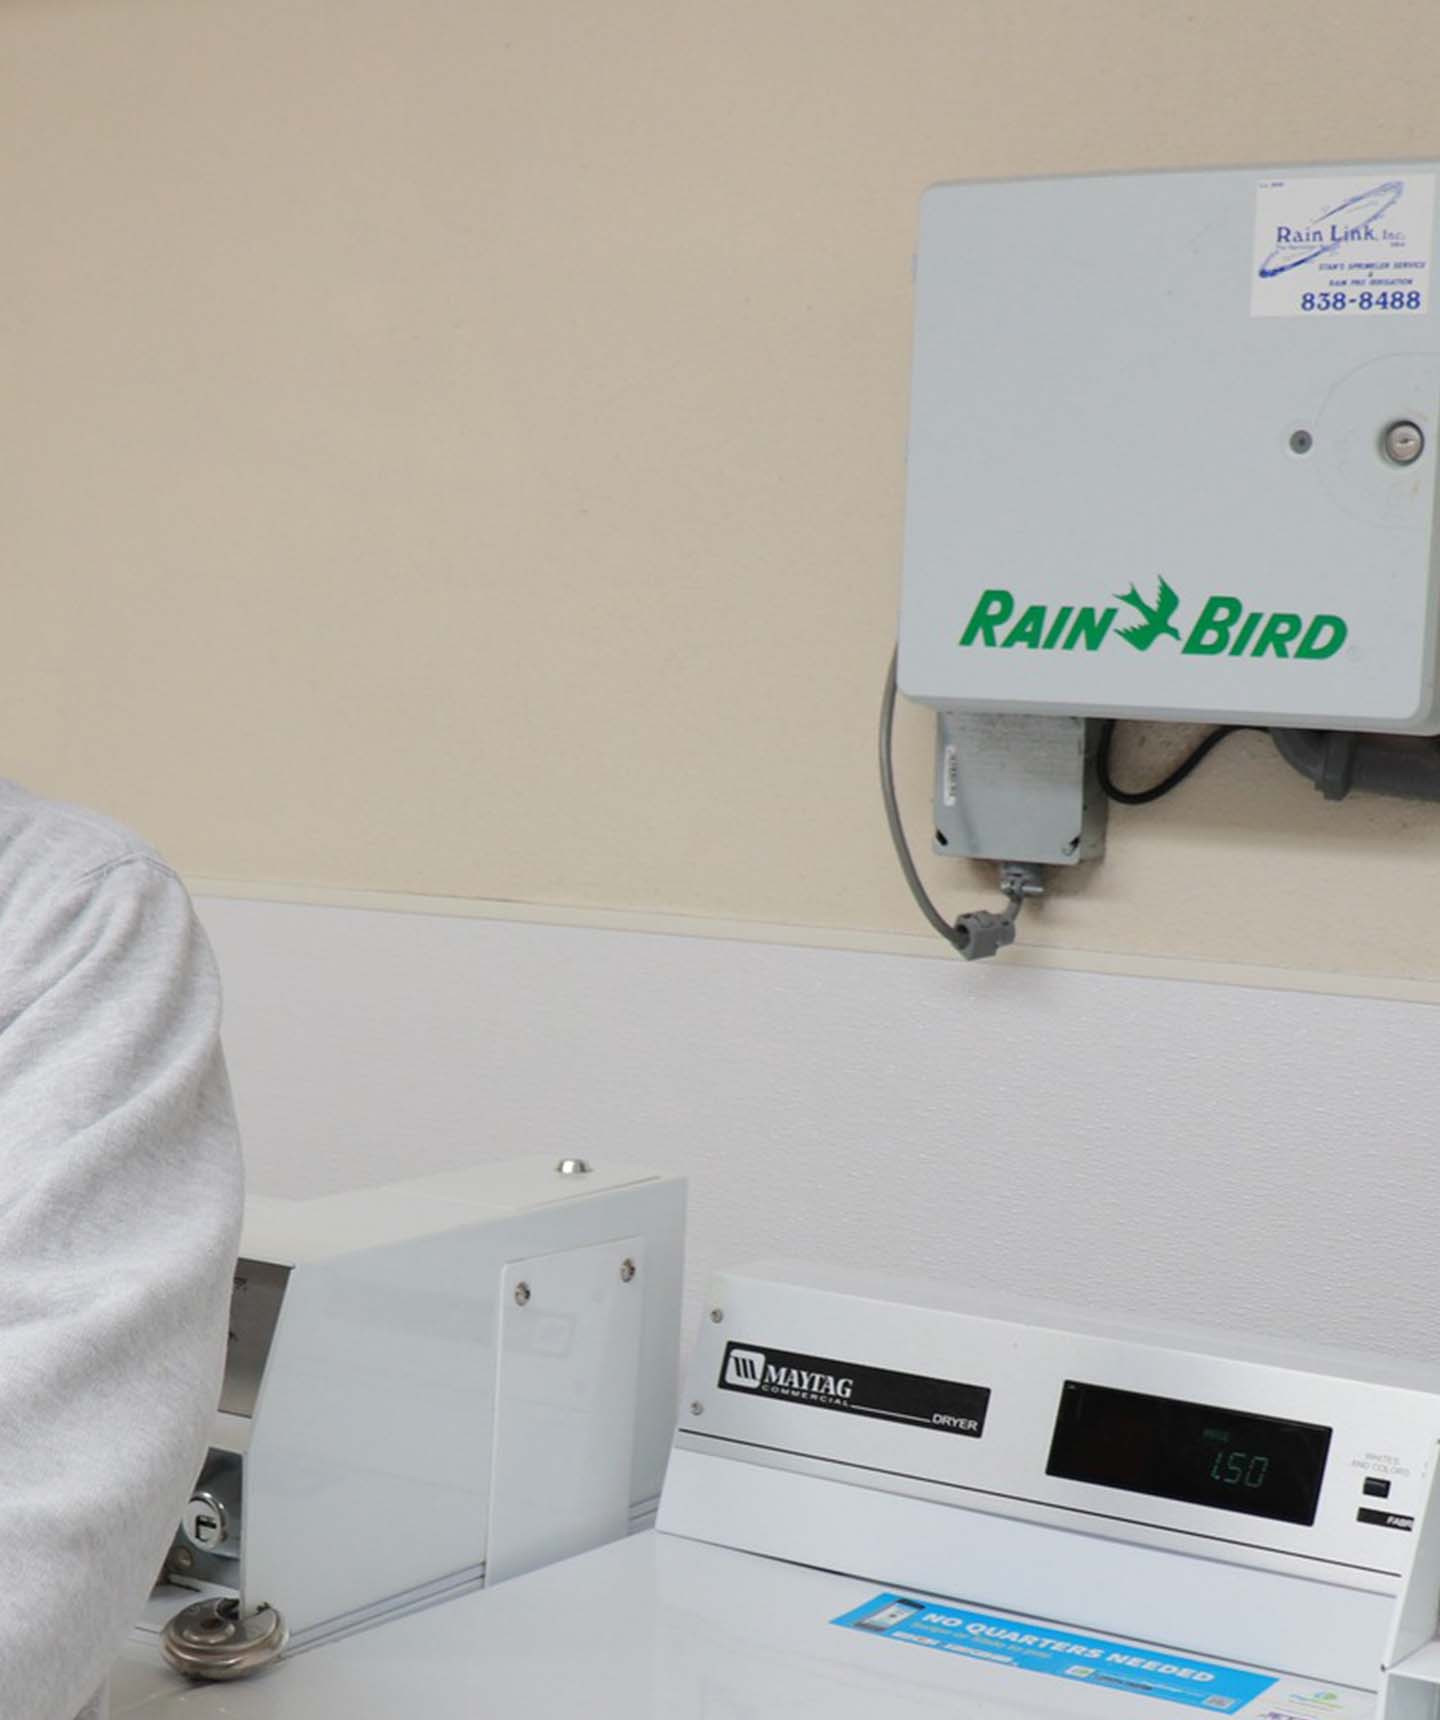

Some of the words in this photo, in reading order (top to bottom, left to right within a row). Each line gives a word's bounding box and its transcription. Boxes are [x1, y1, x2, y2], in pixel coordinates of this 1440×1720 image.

[1276, 226, 1323, 242] Rain
[1301, 291, 1421, 311] 838-8488
[959, 589, 1118, 652] RAIN
[1181, 595, 1348, 660] BIRD
[764, 1364, 854, 1399] MAYTAG
[761, 1384, 850, 1408] COMMERCIAL
[931, 1412, 979, 1432] DRYER
[921, 1613, 964, 1628] NO
[965, 1622, 1105, 1660] QUARTERS
[1106, 1652, 1216, 1683] NEEDED
